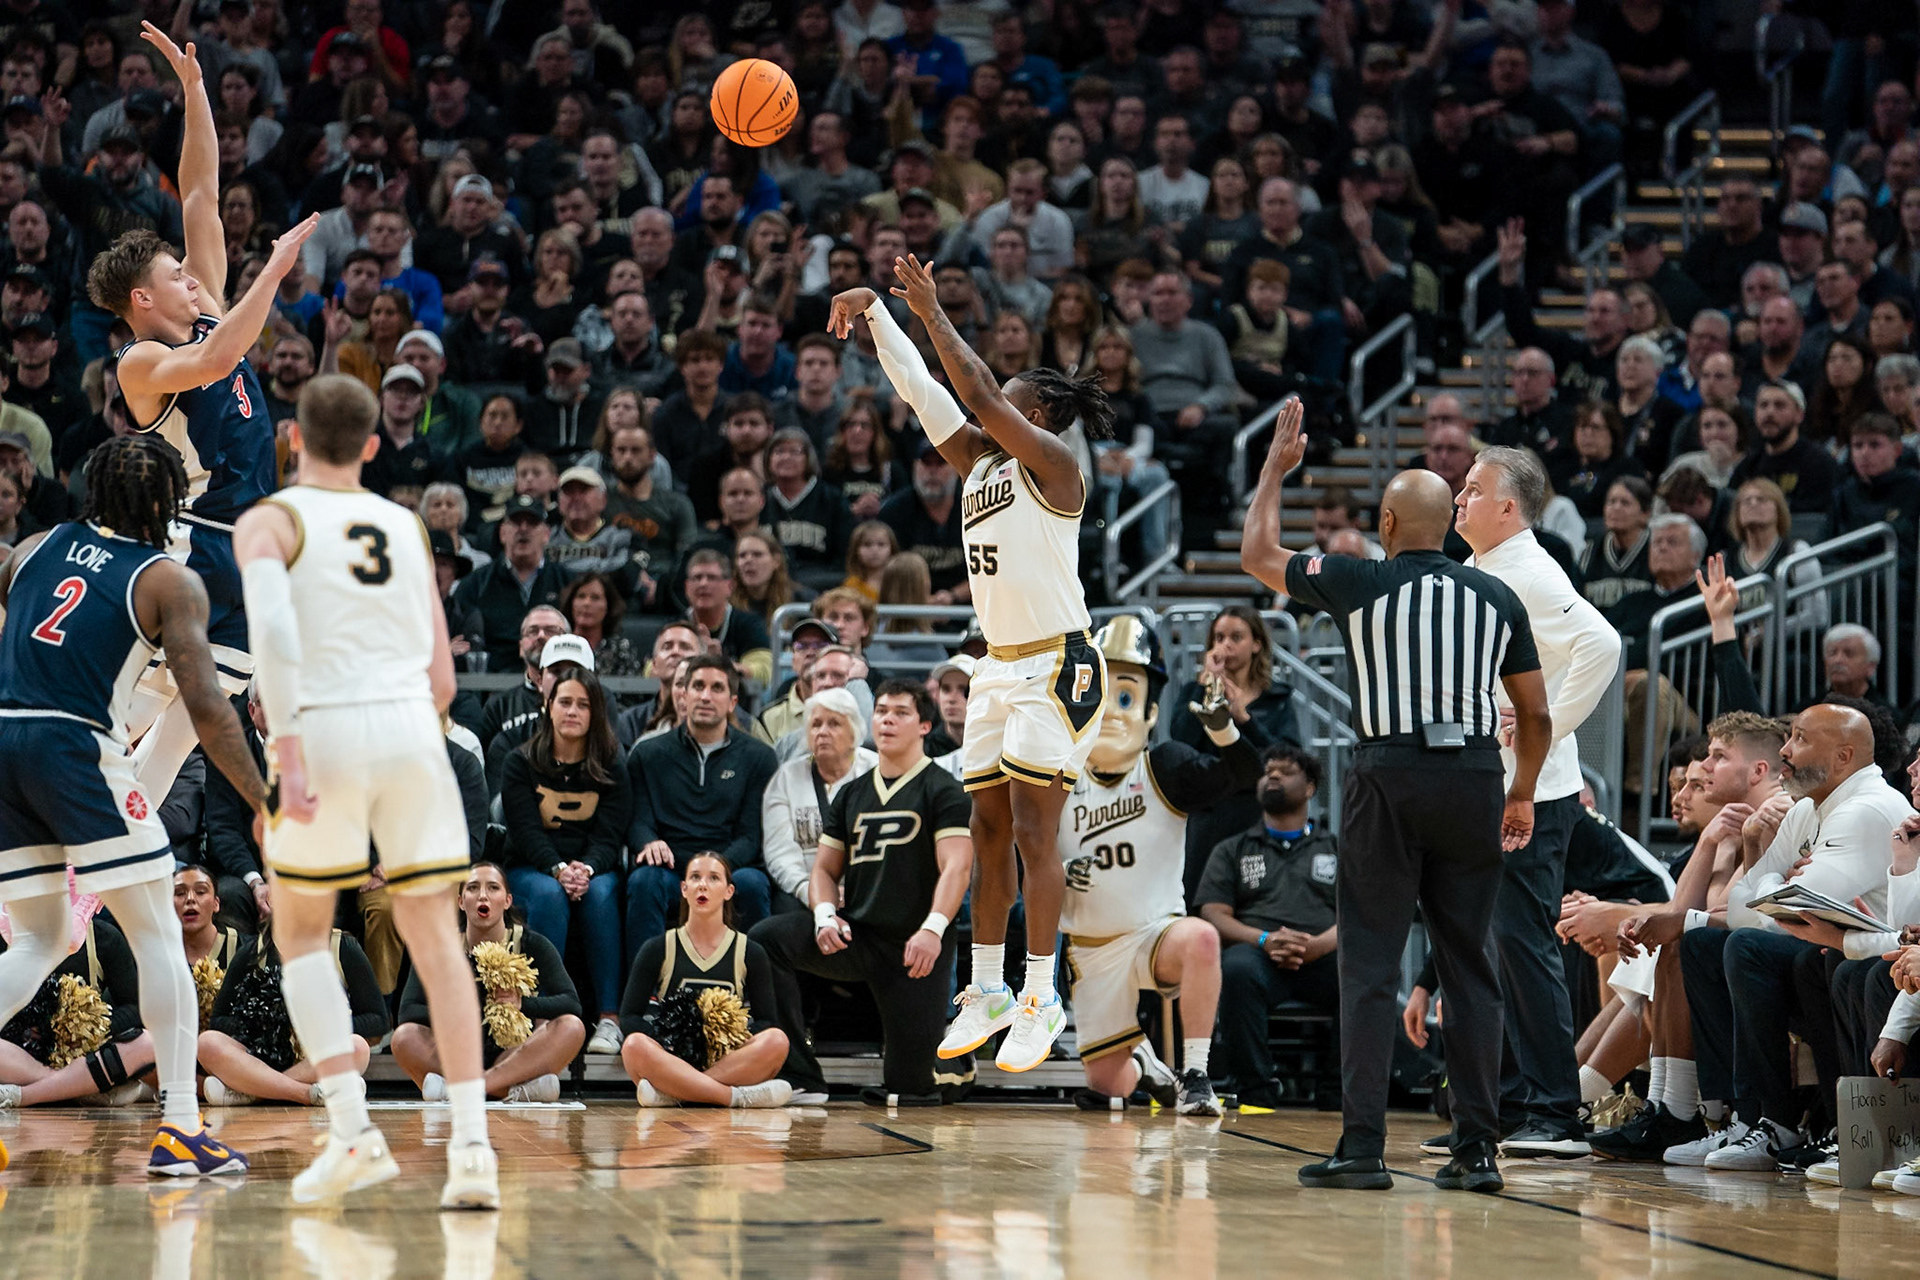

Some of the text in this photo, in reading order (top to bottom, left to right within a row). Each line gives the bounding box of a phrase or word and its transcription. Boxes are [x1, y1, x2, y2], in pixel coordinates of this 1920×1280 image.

[232, 374, 252, 418] 3
[962, 478, 1015, 519] urdue
[65, 541, 114, 573] LOVE
[343, 520, 393, 585] 3
[968, 542, 998, 576] 55
[31, 576, 88, 647] 2
[1071, 663, 1094, 703] P
[1073, 795, 1146, 832] Purdue
[849, 810, 922, 865] P
[1850, 1123, 1874, 1150] Roll
